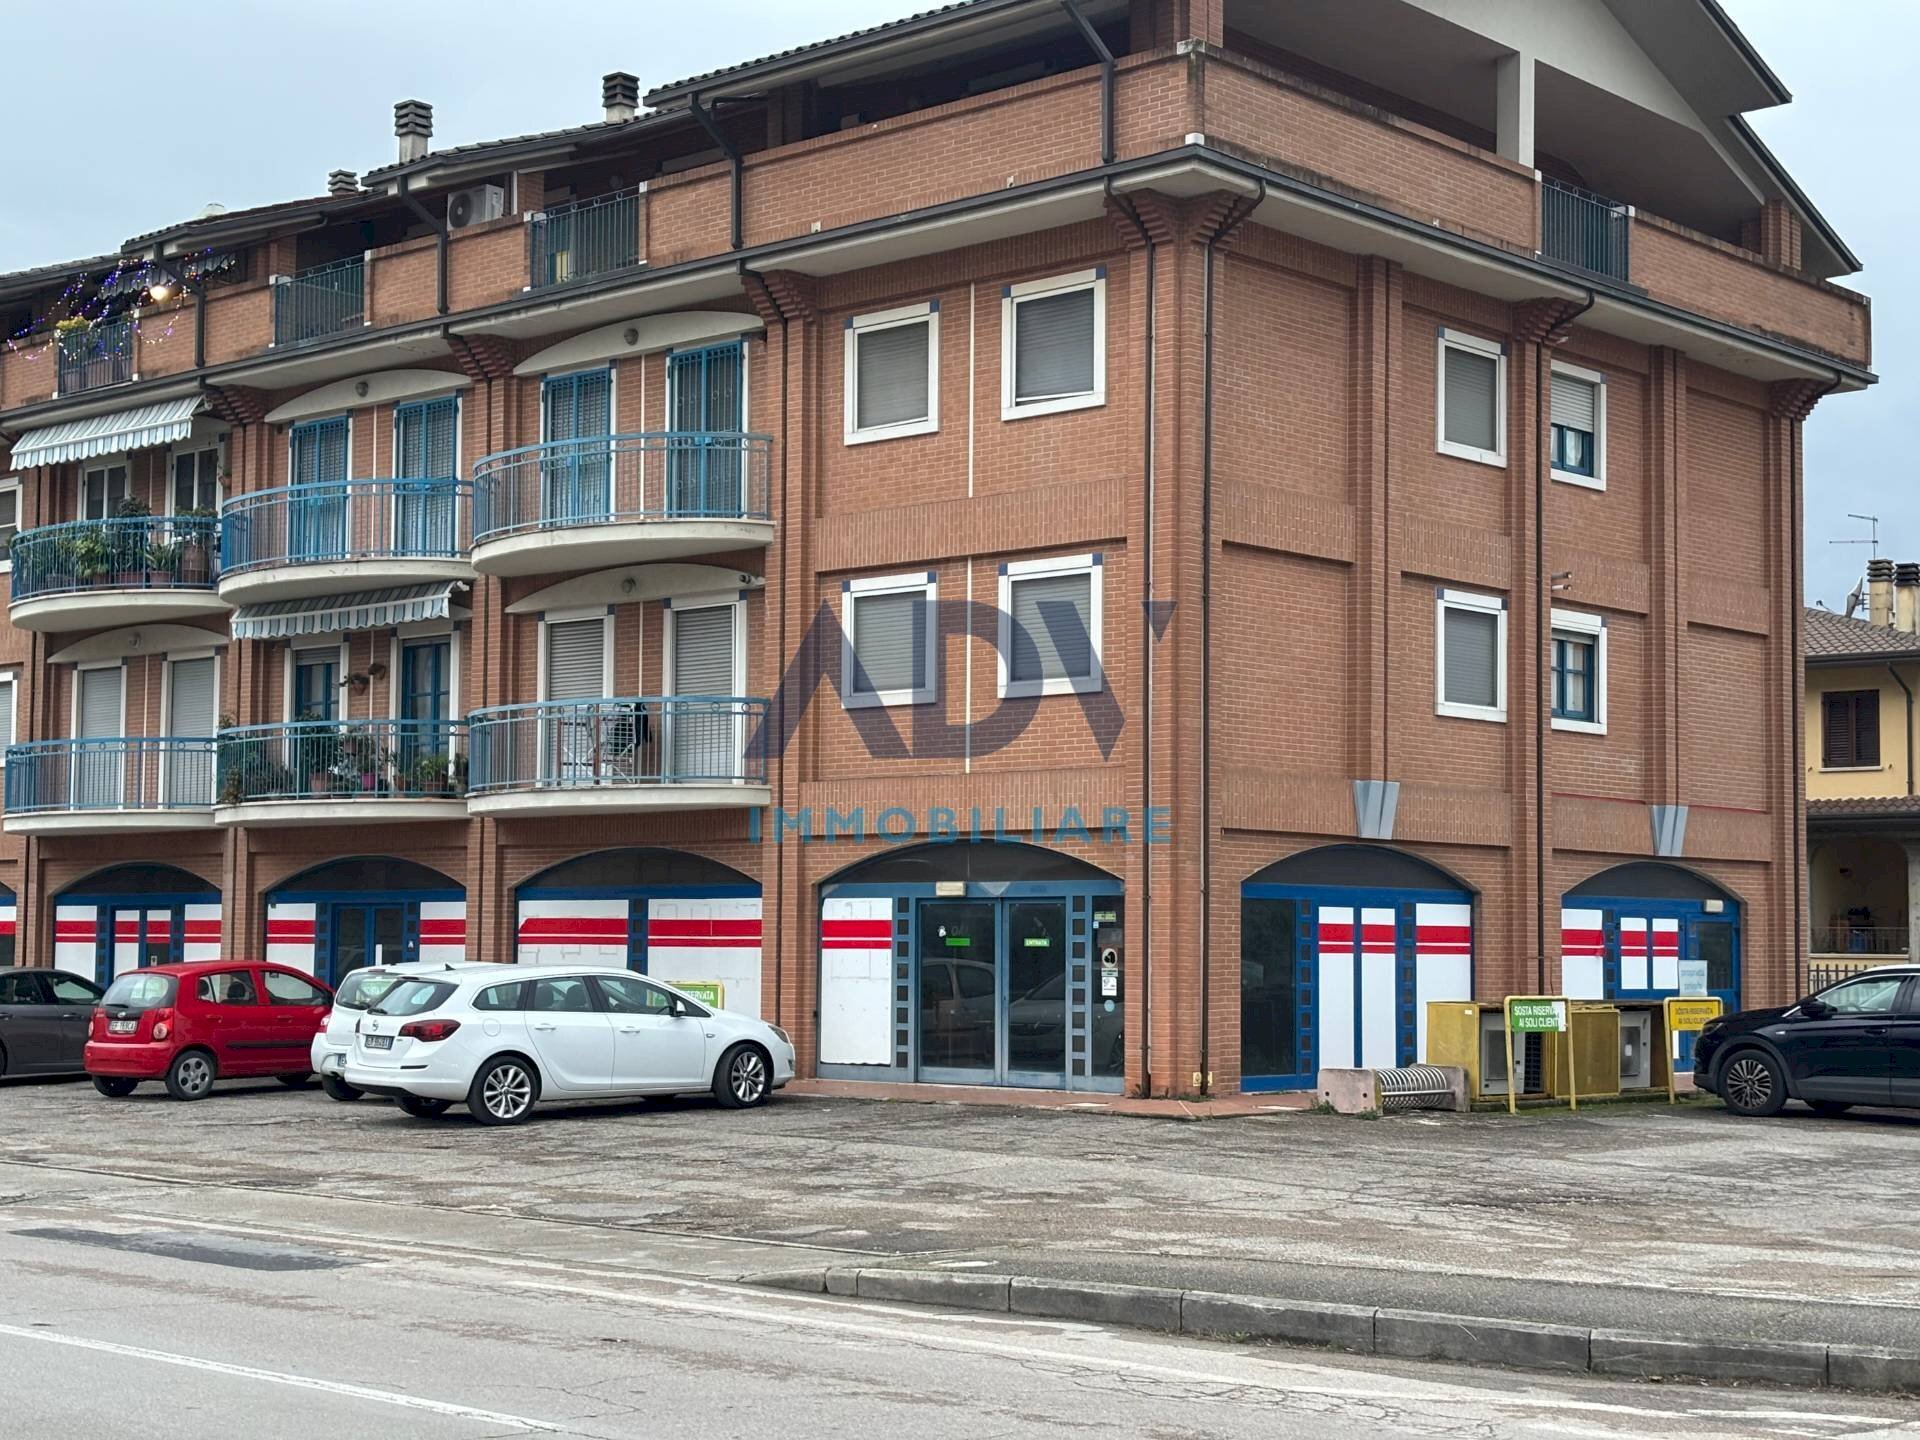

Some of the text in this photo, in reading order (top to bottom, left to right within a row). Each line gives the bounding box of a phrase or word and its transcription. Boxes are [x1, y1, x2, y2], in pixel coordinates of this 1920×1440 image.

[1514, 1005, 1532, 1015] SOSTA
[1519, 1017, 1524, 1028] AI
[1525, 1017, 1538, 1028] SOLI
